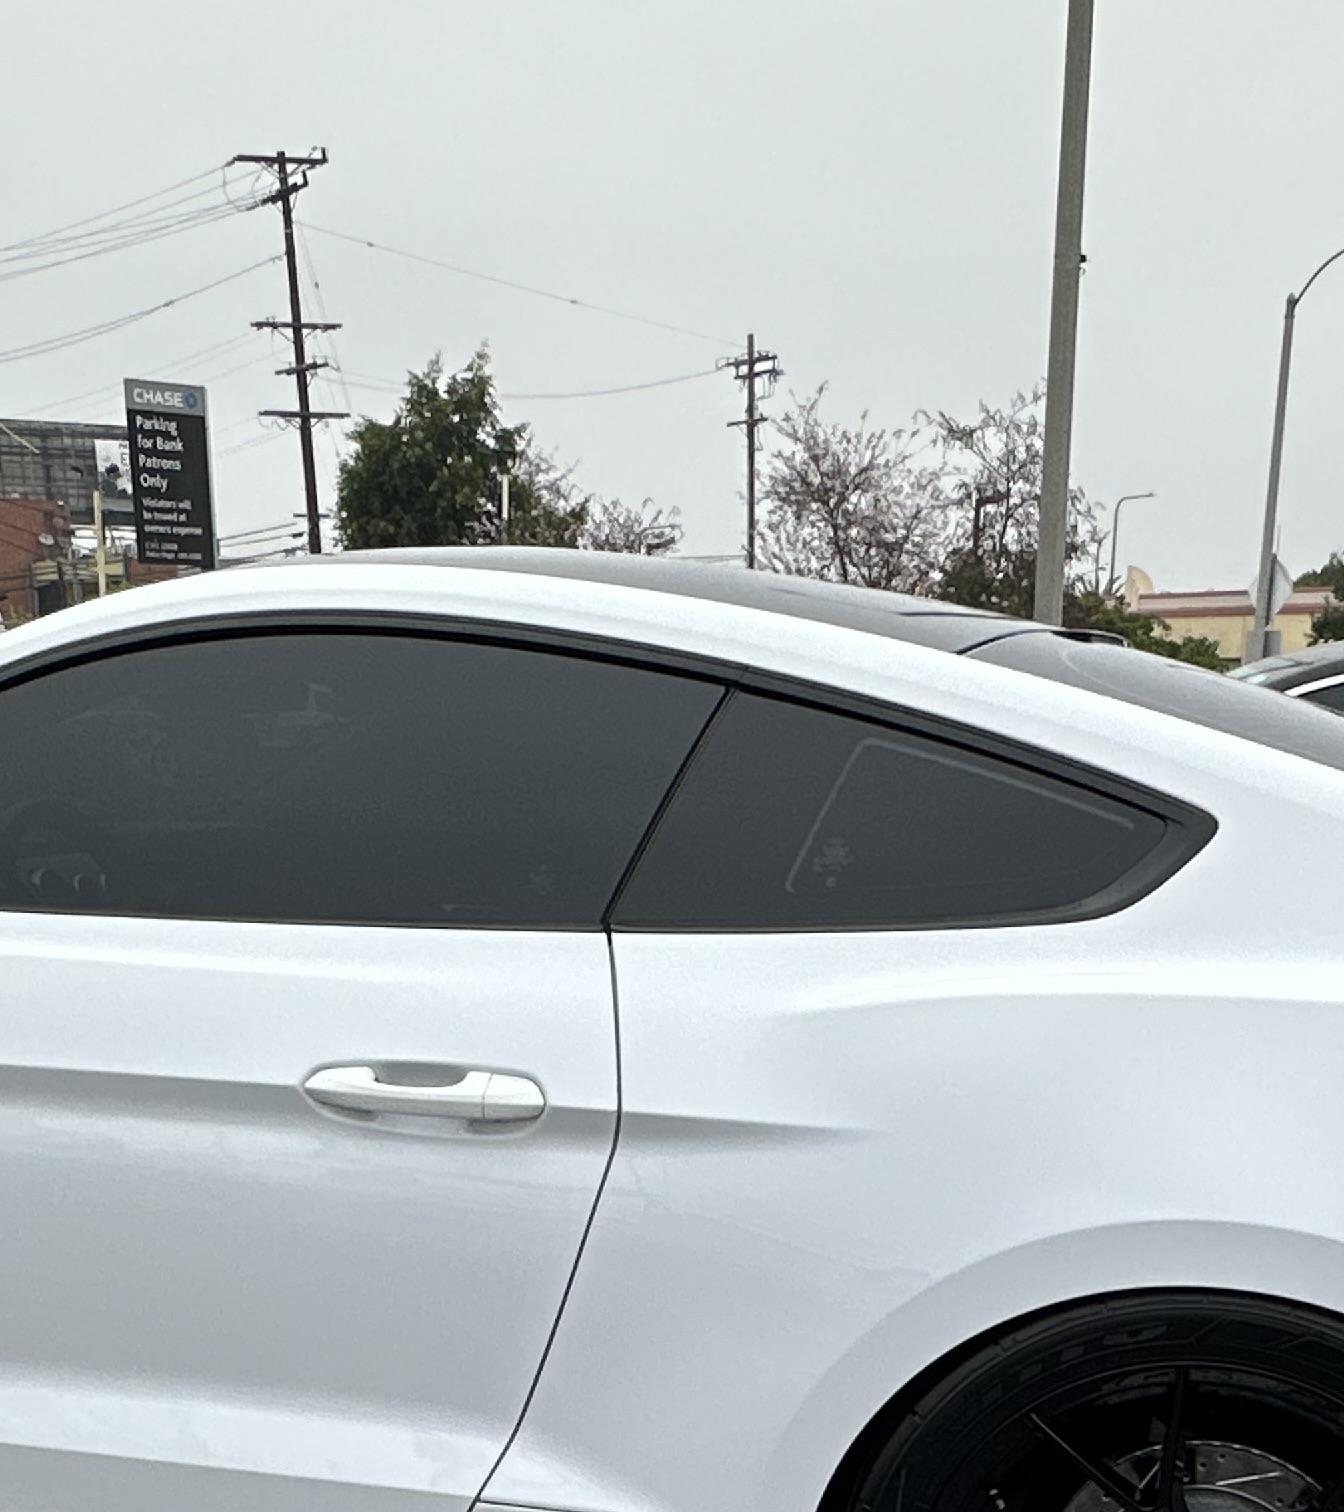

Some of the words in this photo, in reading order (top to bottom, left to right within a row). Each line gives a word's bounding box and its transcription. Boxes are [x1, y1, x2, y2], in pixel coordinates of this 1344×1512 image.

[133, 387, 183, 407] CHASE
[136, 415, 177, 435] Parking
[137, 433, 154, 449] for
[157, 436, 183, 452] Bank
[139, 453, 181, 470] Patrons
[140, 473, 168, 493] Only
